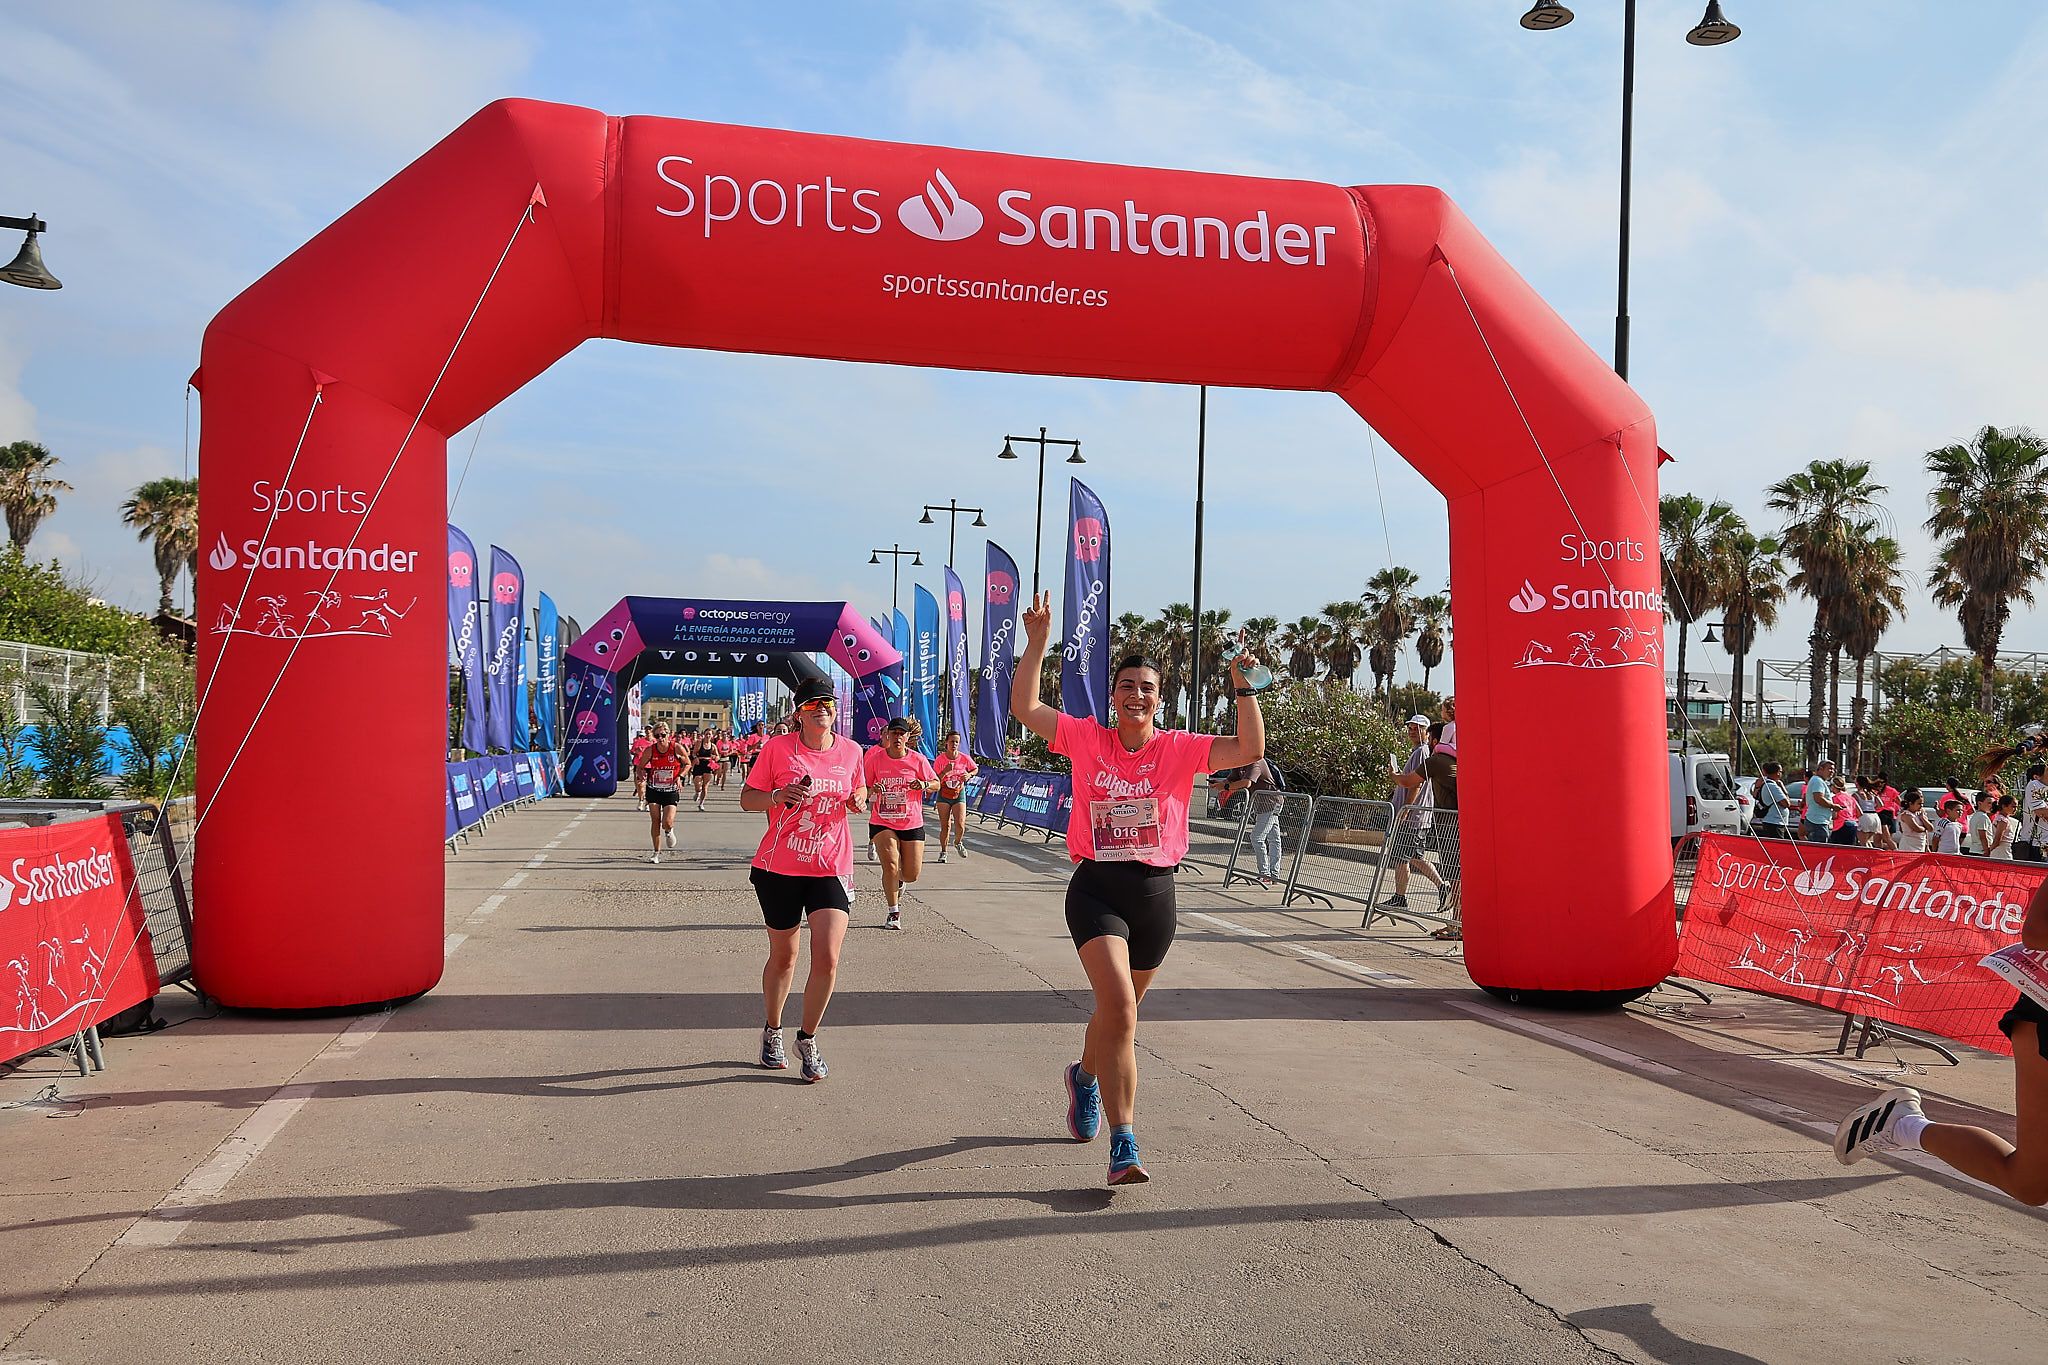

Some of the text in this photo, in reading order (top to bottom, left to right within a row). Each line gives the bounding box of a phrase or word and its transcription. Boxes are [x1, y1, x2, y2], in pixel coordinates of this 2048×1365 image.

[655, 154, 1336, 267] Sports Santander
[881, 271, 1109, 309] sportssantander.es
[252, 480, 368, 520] Sports
[242, 539, 419, 573] Santander
[1560, 533, 1645, 568] Sports
[1552, 584, 1663, 613] Santande
[674, 624, 795, 636] LA ENERGÍA PARA CORRER
[697, 635, 749, 643] VELOCIDAD
[778, 637, 796, 645] LUZ
[658, 650, 769, 664] VOLVO
[793, 776, 844, 794] CRRERA
[1113, 827, 1139, 838] 016
[12, 846, 115, 906] Santander
[1711, 852, 2024, 935] Sports Santande
